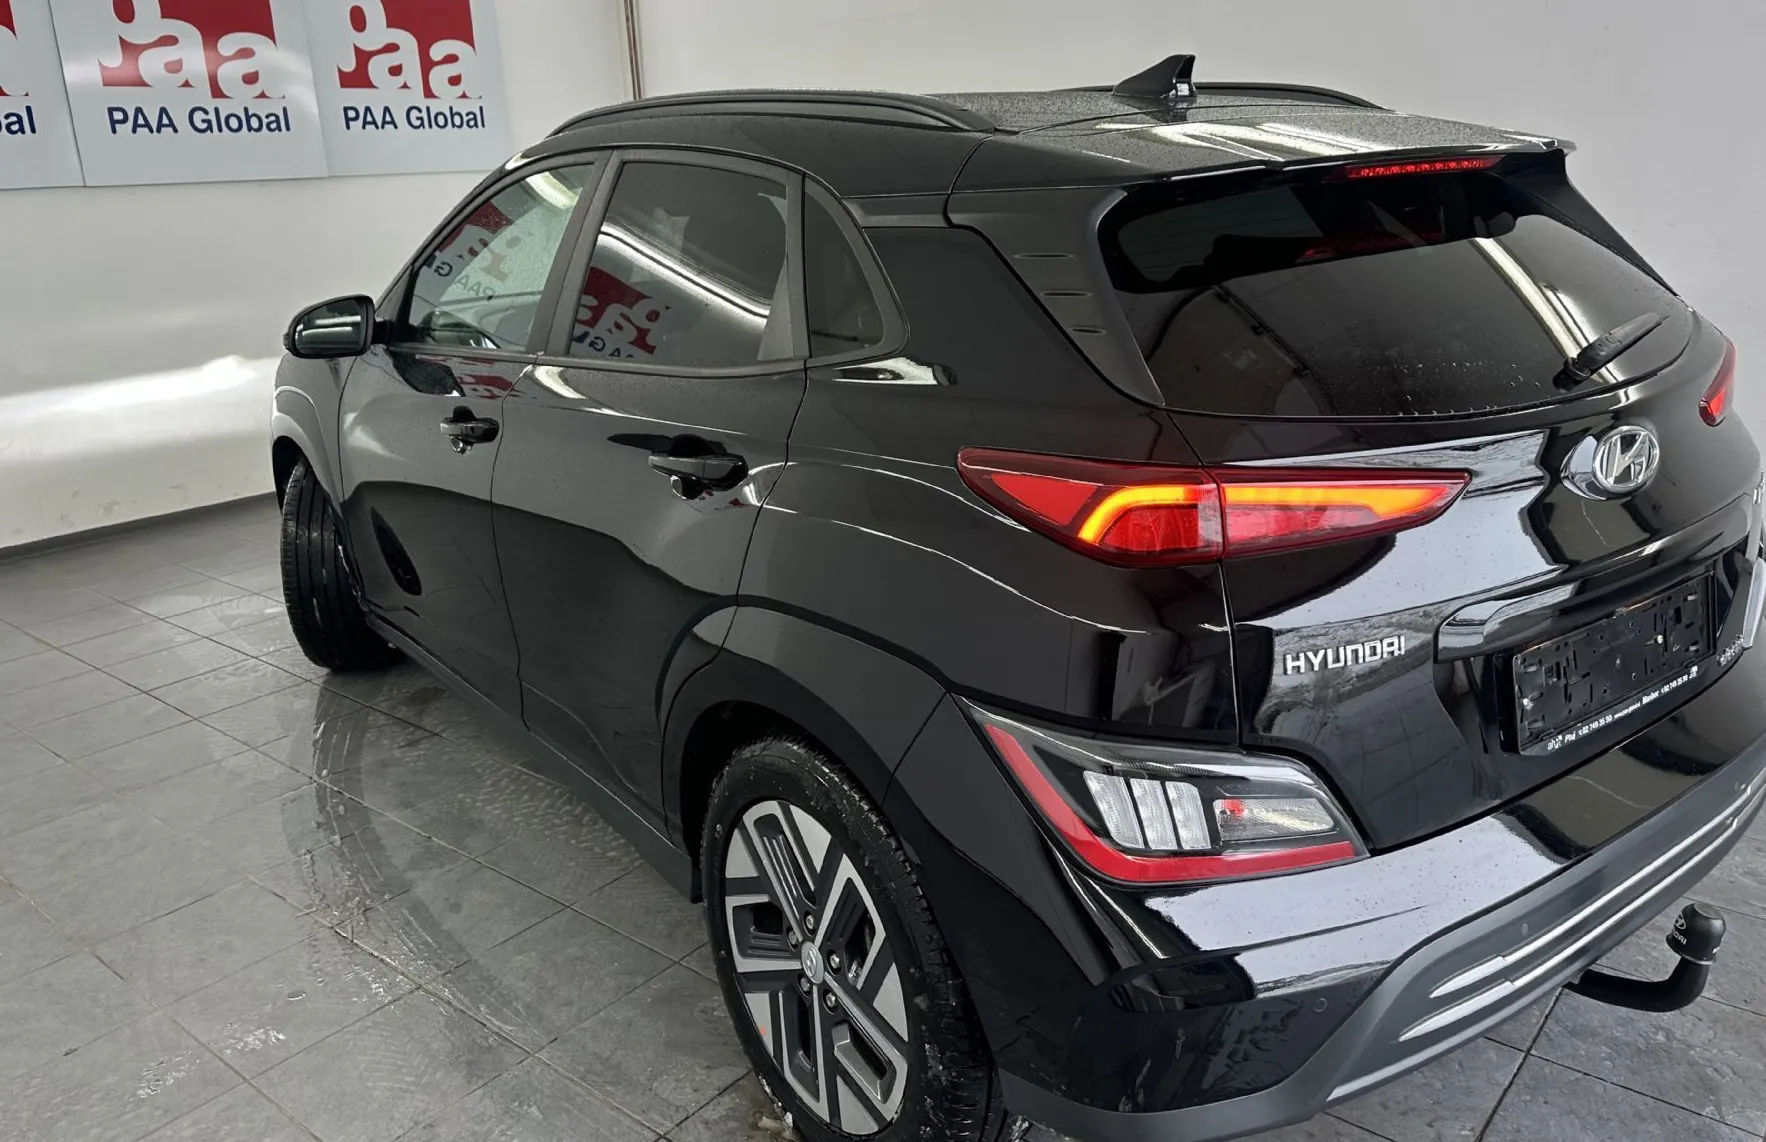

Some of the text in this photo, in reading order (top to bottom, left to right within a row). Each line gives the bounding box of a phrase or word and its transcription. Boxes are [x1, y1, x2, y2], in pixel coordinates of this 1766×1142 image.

[0, 105, 37, 135] al
[107, 106, 291, 134] PAA Global
[342, 105, 485, 130] PAA Global
[1285, 635, 1405, 675] HYUNDAI
